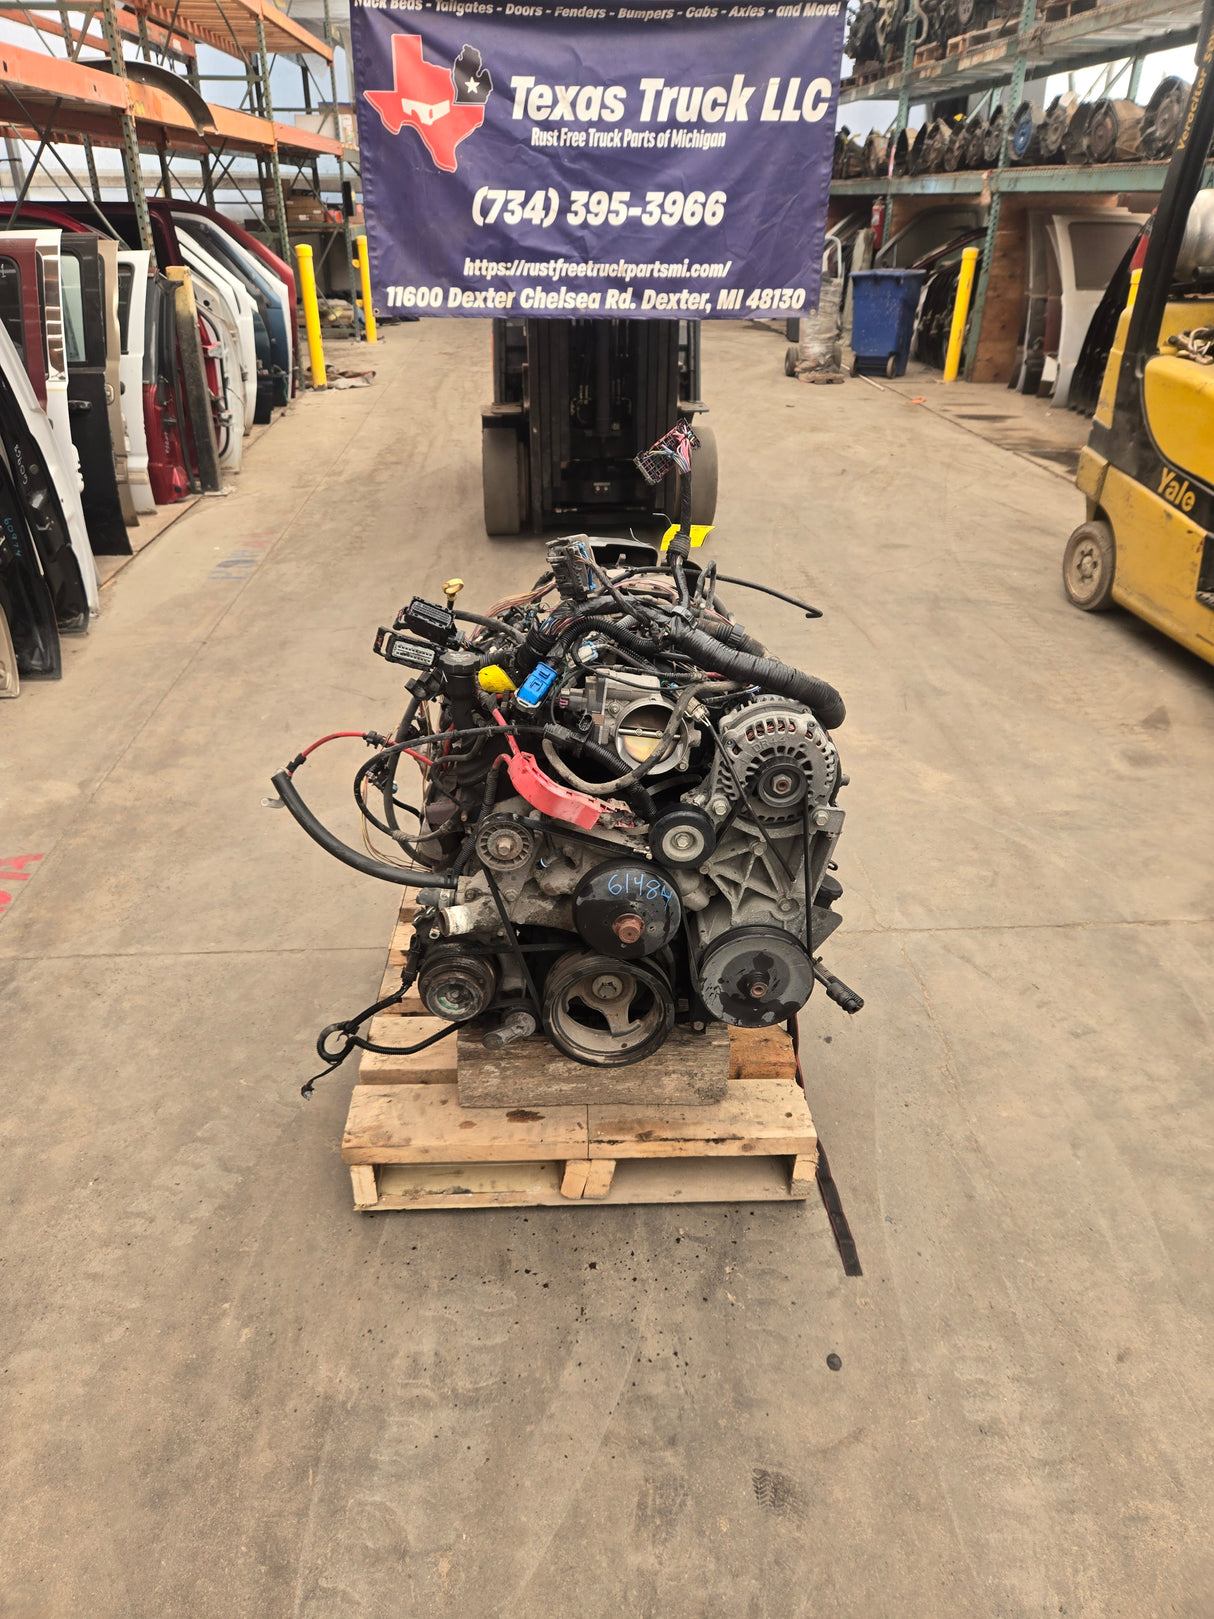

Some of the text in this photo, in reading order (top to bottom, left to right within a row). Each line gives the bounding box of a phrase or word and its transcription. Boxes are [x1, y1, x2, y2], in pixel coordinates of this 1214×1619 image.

[435, 0, 494, 16] Tailgates
[505, 3, 543, 16] Doors
[554, 6, 606, 19] Fenders
[617, 7, 674, 21] Bumpers
[685, 5, 718, 18] Cabs
[728, 4, 765, 18] Axles
[776, 4, 801, 17] and
[802, 1, 840, 17] More!
[510, 73, 833, 122] Texas Truck LLC
[1176, 66, 1207, 150] Veracitor
[531, 127, 727, 150] Rust Free Truck Parts of Michigan
[472, 186, 727, 228] (734) 395-3966
[463, 257, 733, 282] https://rustfreetruckpartsmi.com/
[386, 286, 806, 313] 11600 Dexter Chelsea Rd. Dexter, MI 48130
[1157, 466, 1196, 512] Yale
[607, 873, 674, 912] 61484
